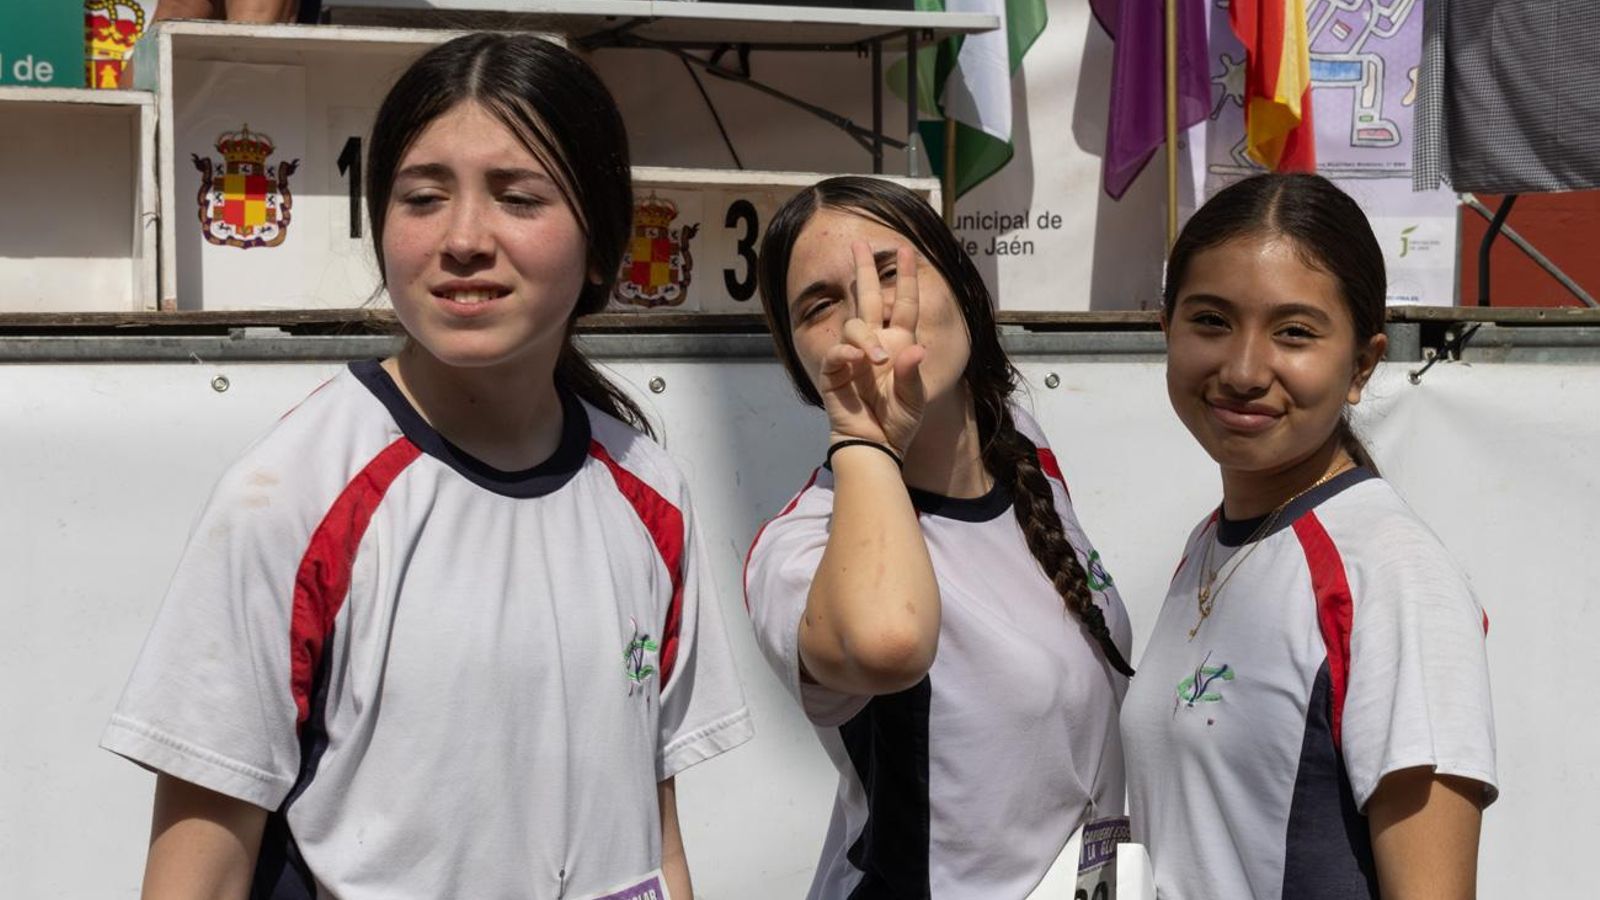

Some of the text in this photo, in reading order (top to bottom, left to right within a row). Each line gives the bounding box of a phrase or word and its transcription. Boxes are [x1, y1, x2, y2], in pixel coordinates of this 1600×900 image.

[13, 54, 54, 82] de
[337, 136, 362, 239] 1
[1036, 211, 1063, 230] de
[723, 199, 759, 302] 3
[985, 235, 1034, 256] Jaén
